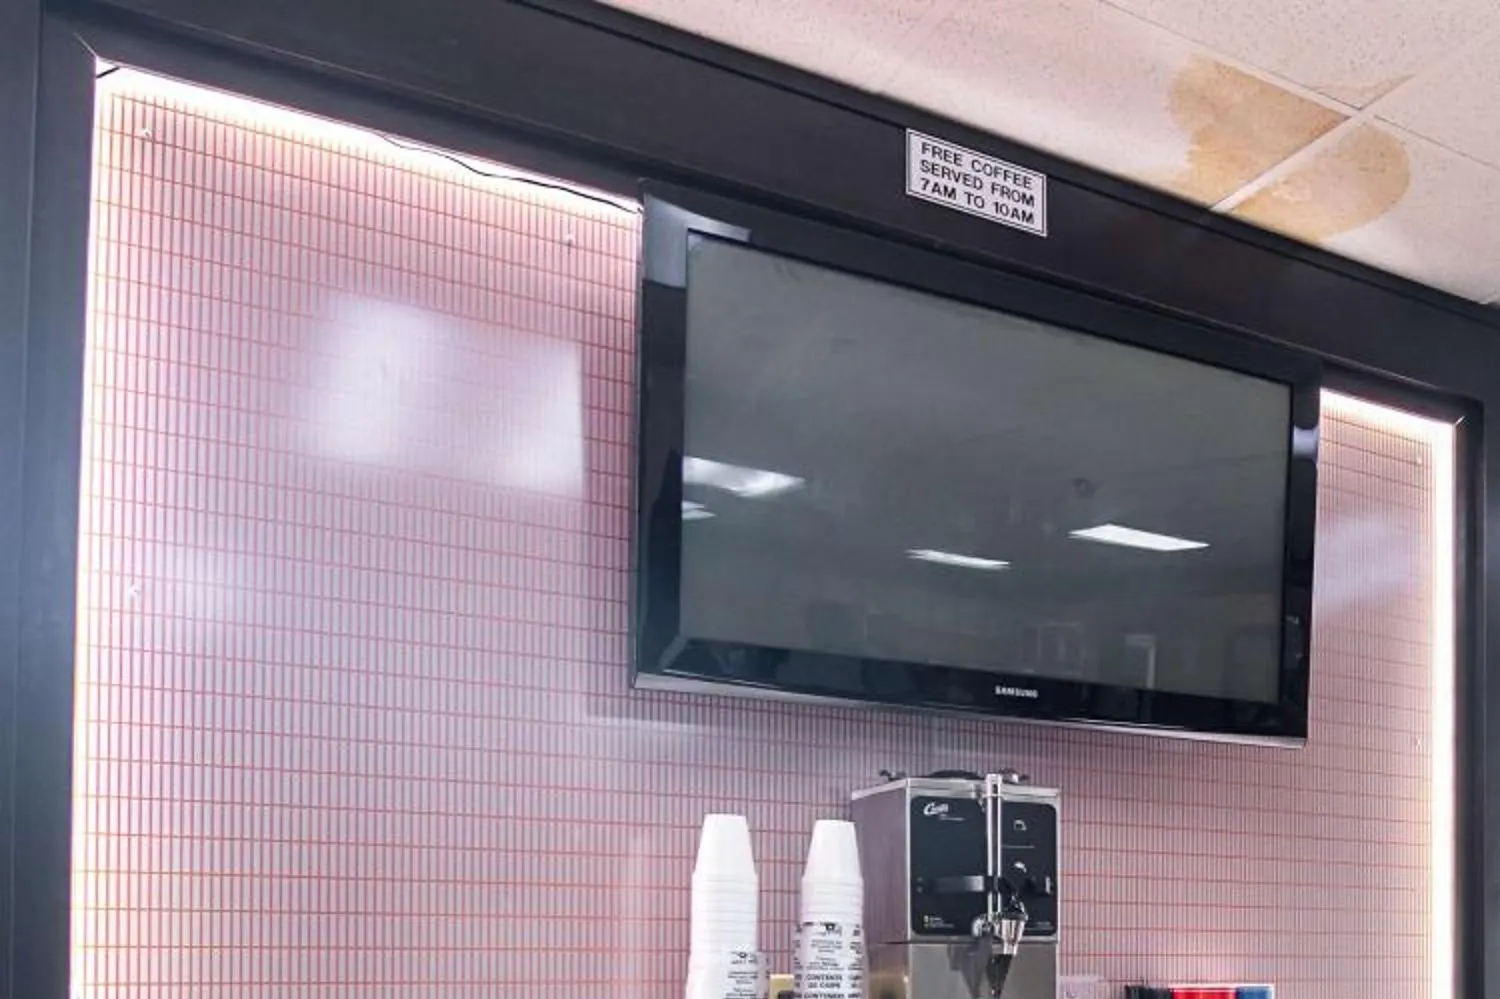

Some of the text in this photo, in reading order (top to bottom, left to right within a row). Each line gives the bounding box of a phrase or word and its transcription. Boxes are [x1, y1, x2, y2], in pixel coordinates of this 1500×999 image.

[920, 141, 1033, 189] FREE COFFEE
[920, 159, 1035, 207] SERVED FROM
[920, 177, 1035, 225] 7AM TO 10AM
[995, 685, 1039, 698] SAMSUNG
